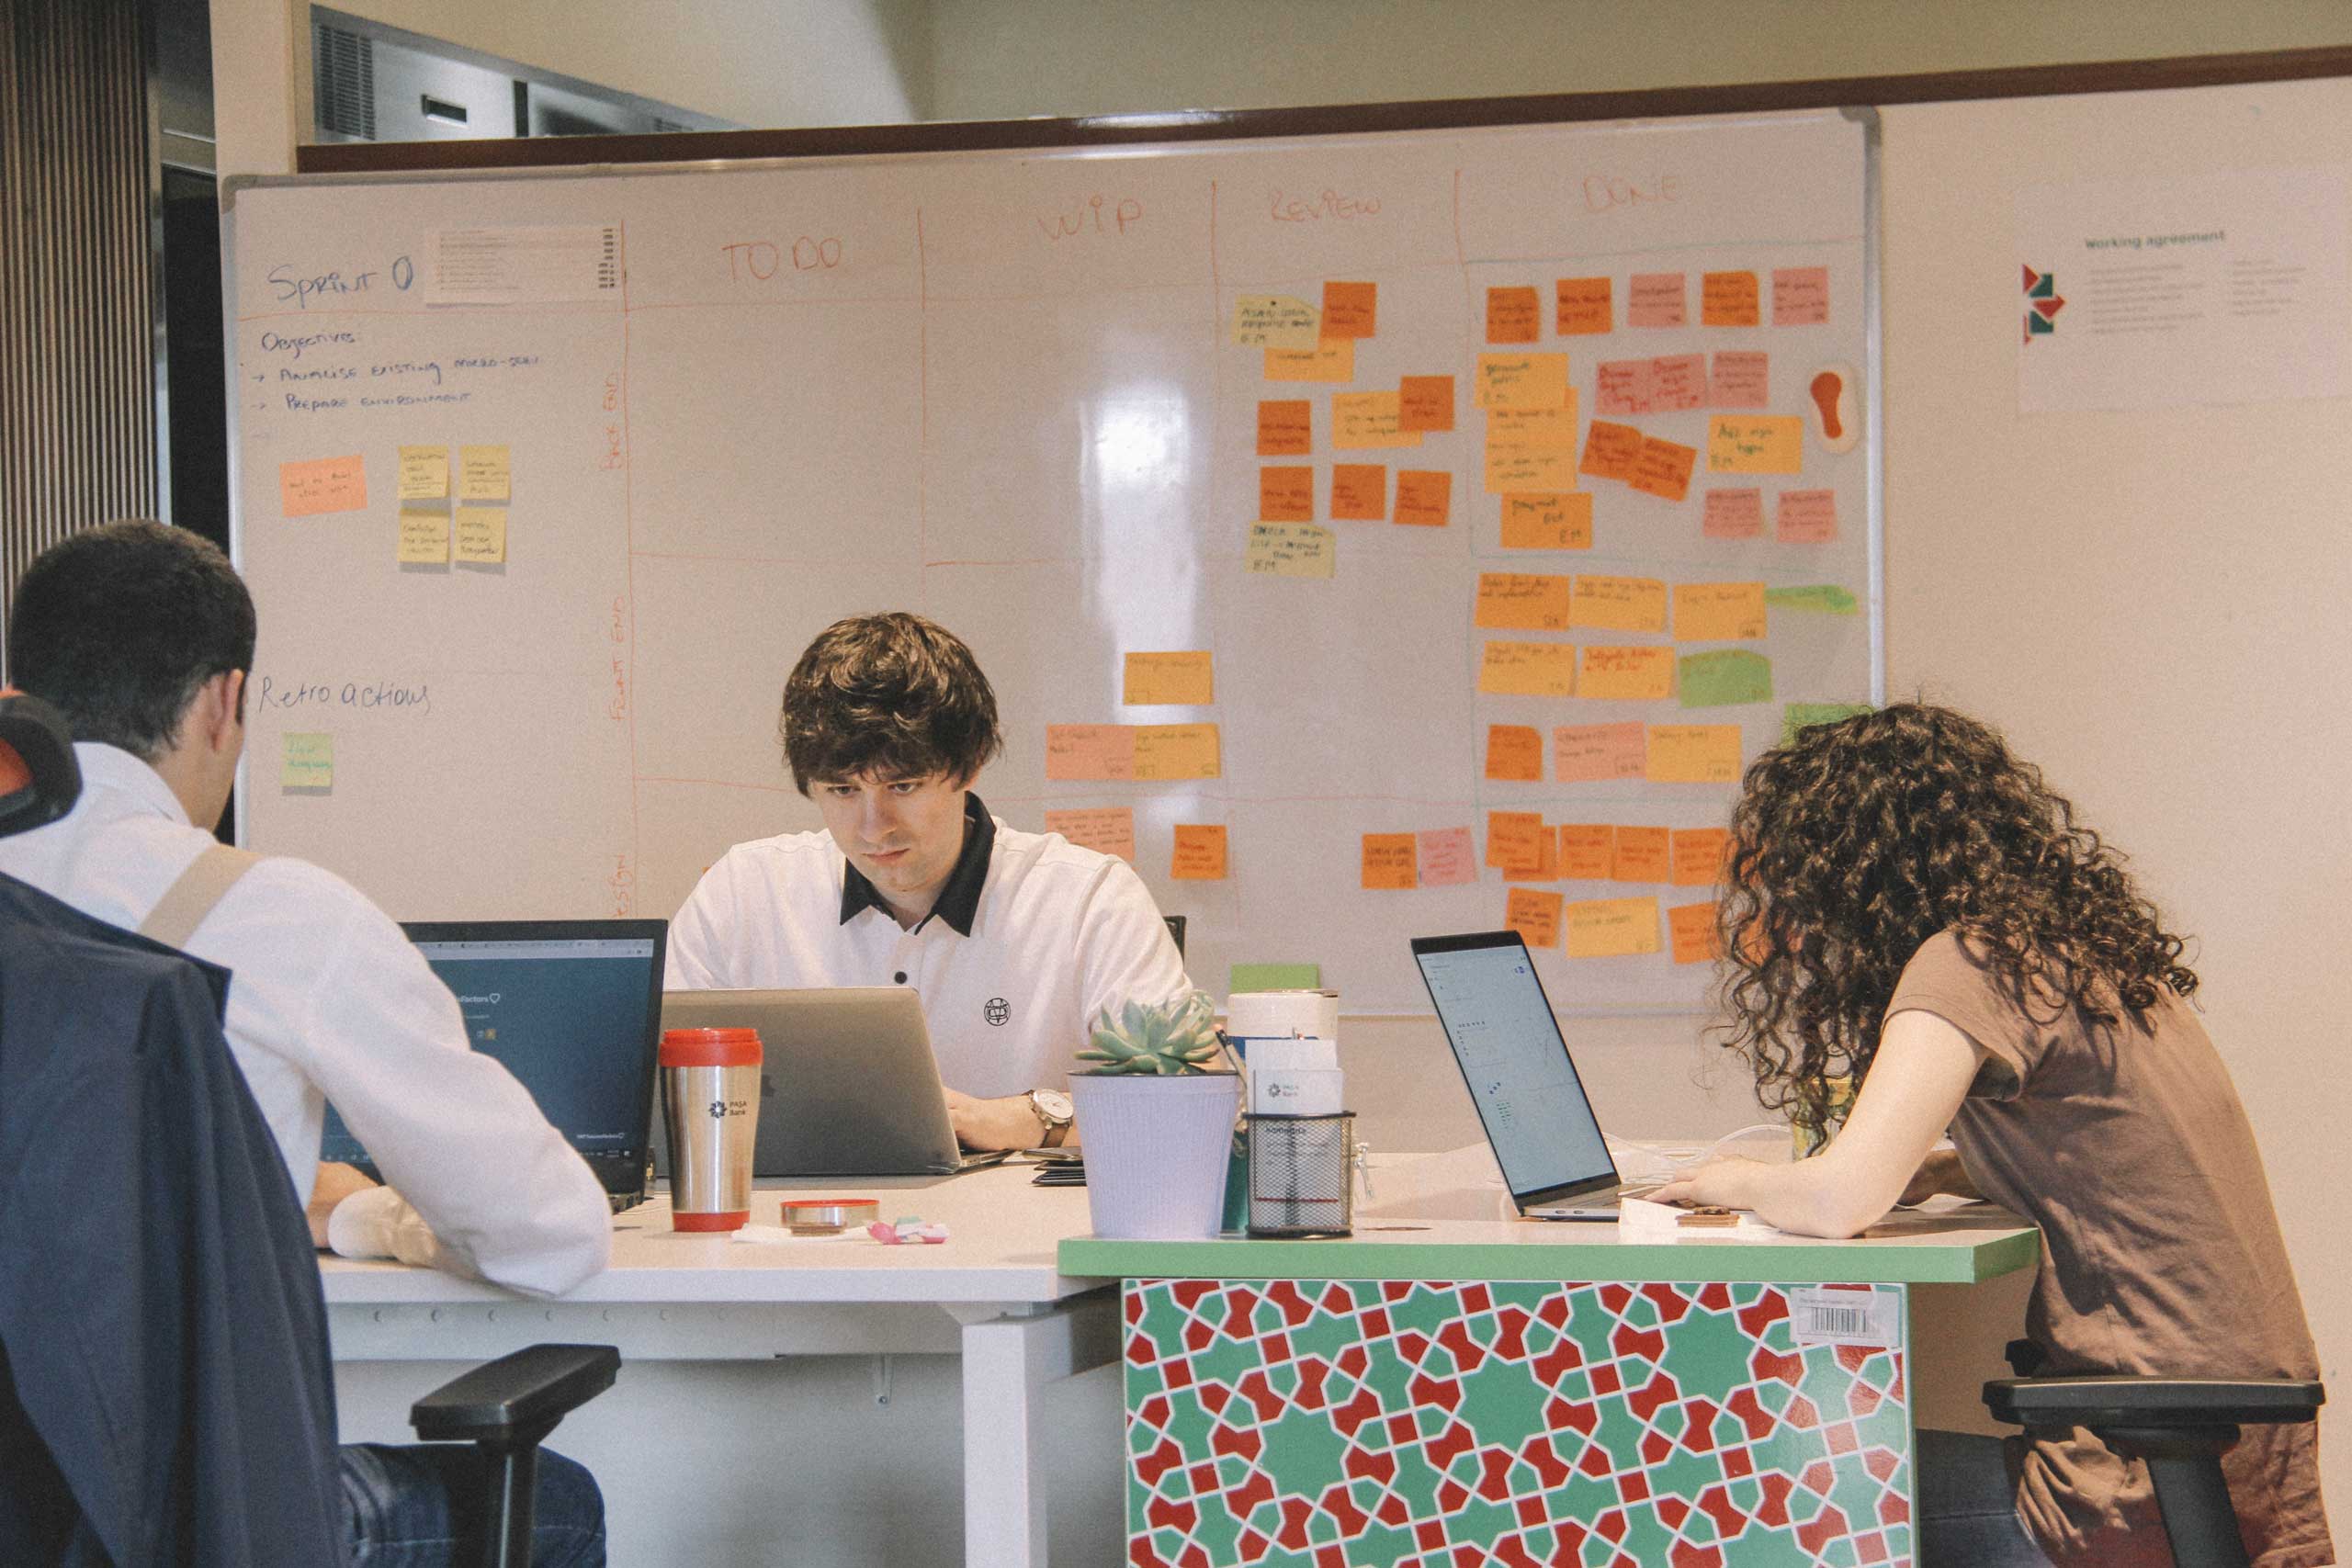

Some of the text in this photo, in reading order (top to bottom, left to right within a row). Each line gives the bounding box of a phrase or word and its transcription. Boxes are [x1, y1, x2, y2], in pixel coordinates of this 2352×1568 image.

[2086, 231, 2224, 250] Working agreement
[258, 675, 331, 714] Retro
[729, 1109, 746, 1117] Bank
